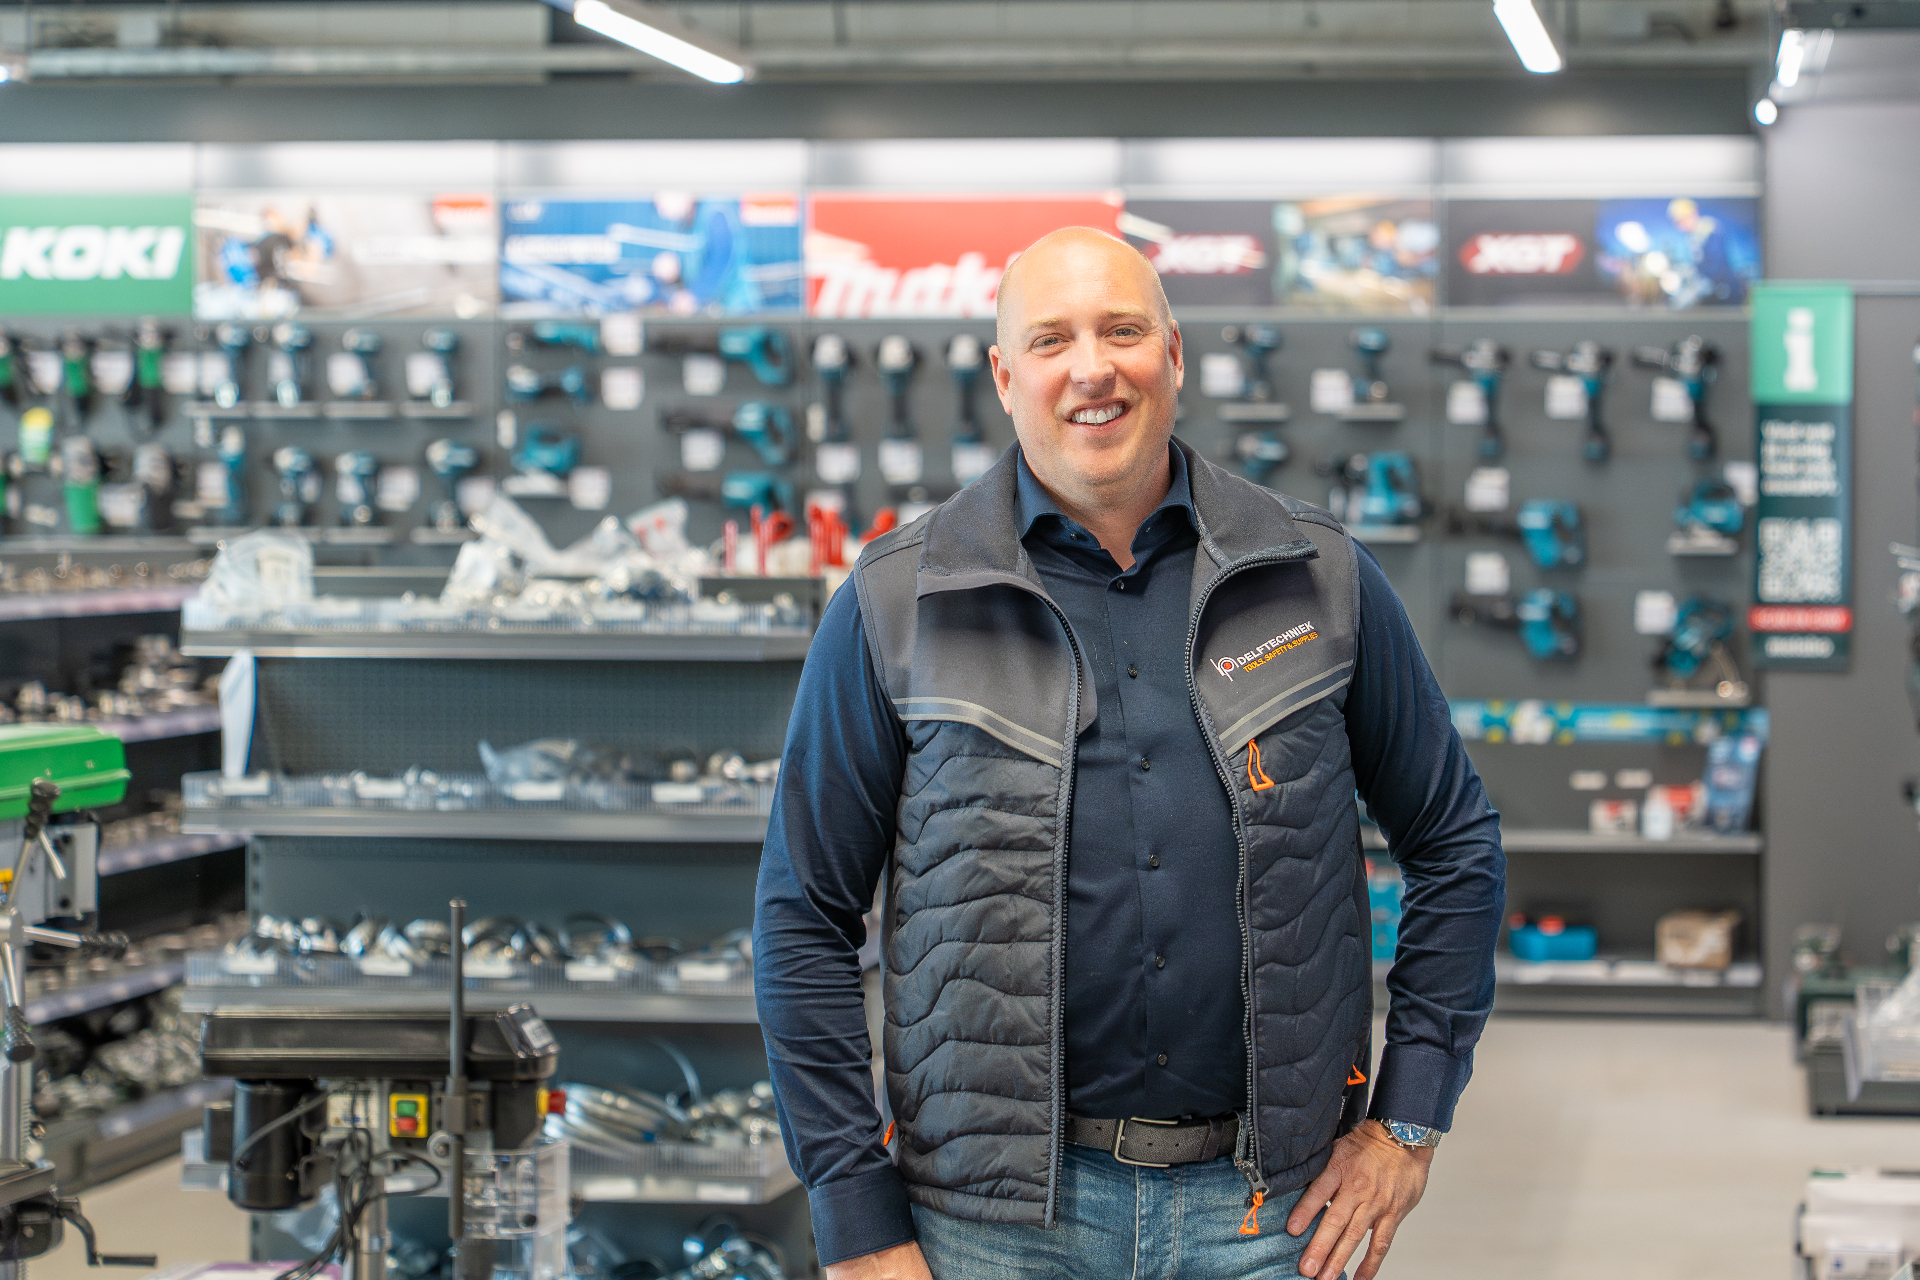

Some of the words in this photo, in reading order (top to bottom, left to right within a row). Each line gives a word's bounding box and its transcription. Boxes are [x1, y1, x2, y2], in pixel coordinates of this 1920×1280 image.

[1470, 233, 1577, 273] XGT
[1236, 620, 1315, 666] DELFTECHNIEK
[1243, 657, 1267, 673] TOOLS,
[1264, 645, 1288, 662] SAFETY
[1293, 631, 1319, 648] SUPPLIES
